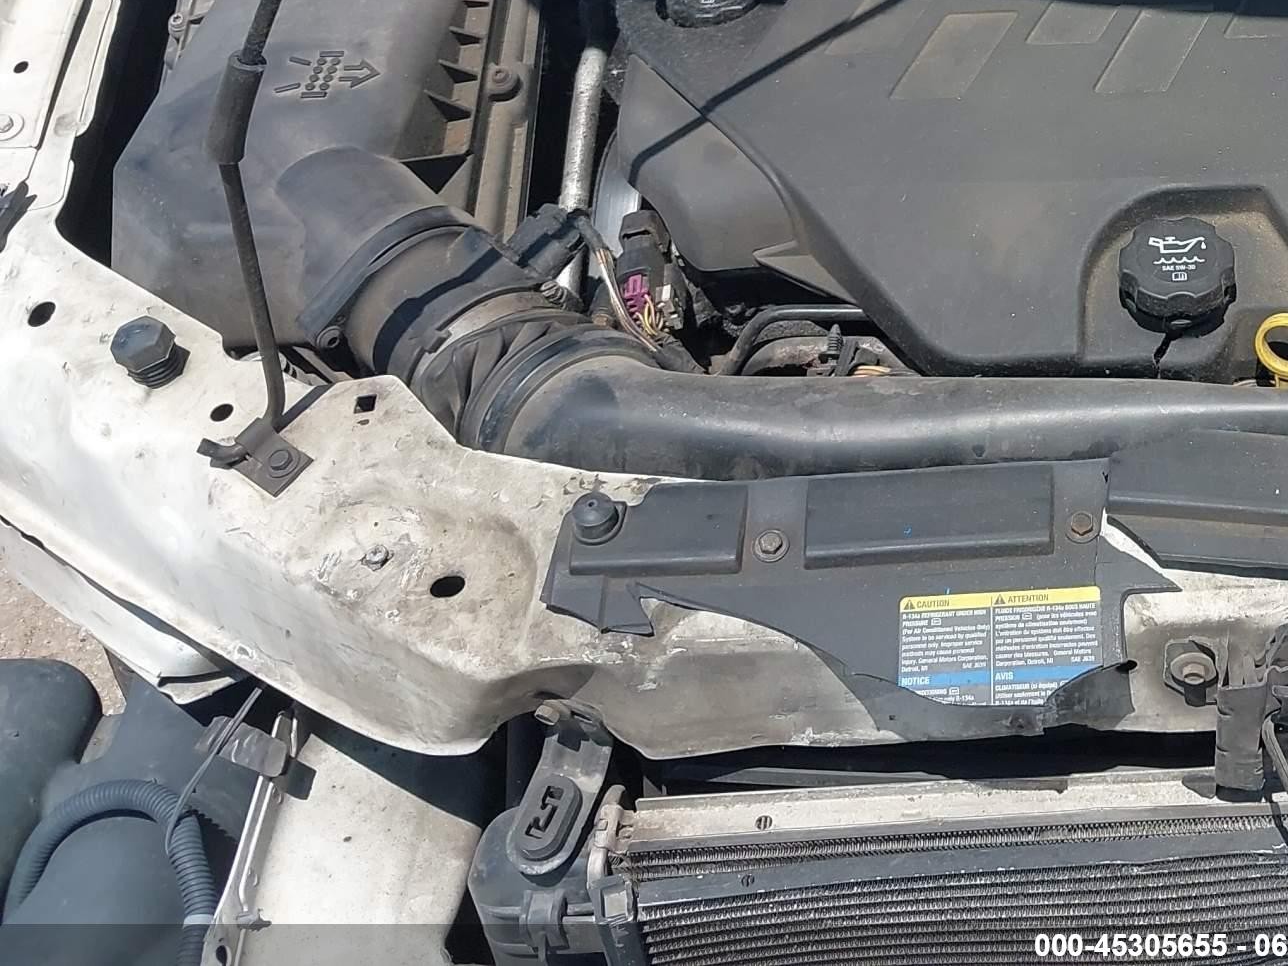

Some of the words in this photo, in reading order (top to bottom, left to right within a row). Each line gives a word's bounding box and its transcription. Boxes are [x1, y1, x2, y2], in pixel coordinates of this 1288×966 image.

[916, 598, 950, 609] CAUTION
[1007, 593, 1049, 604] ATTENTION
[901, 676, 931, 687] NOTICE
[994, 671, 1014, 681] AVIS
